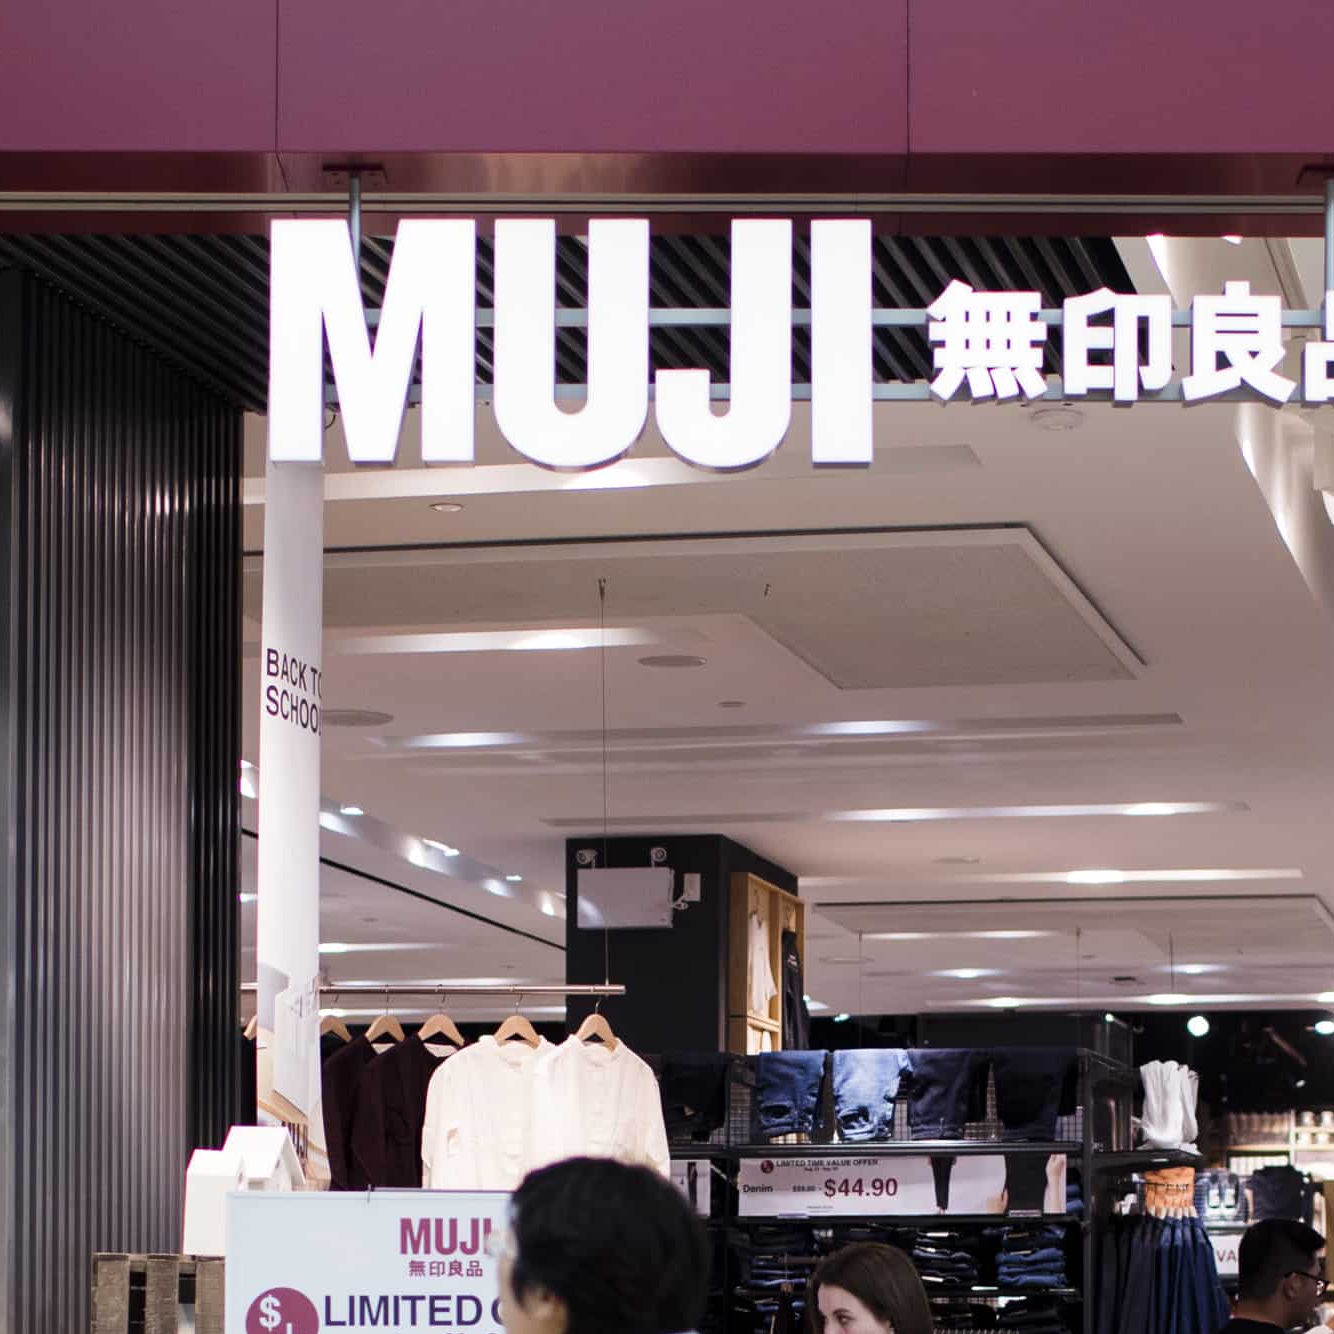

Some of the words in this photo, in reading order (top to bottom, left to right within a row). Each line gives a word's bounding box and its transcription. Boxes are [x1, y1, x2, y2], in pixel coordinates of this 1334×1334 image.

[269, 218, 872, 472] MUJI
[266, 648, 307, 692] BACK
[742, 1184, 773, 1193] Denim
[824, 1177, 899, 1198] $44.90
[408, 1260, 484, 1278] 無印良品
[324, 1294, 483, 1327] LIMITED
